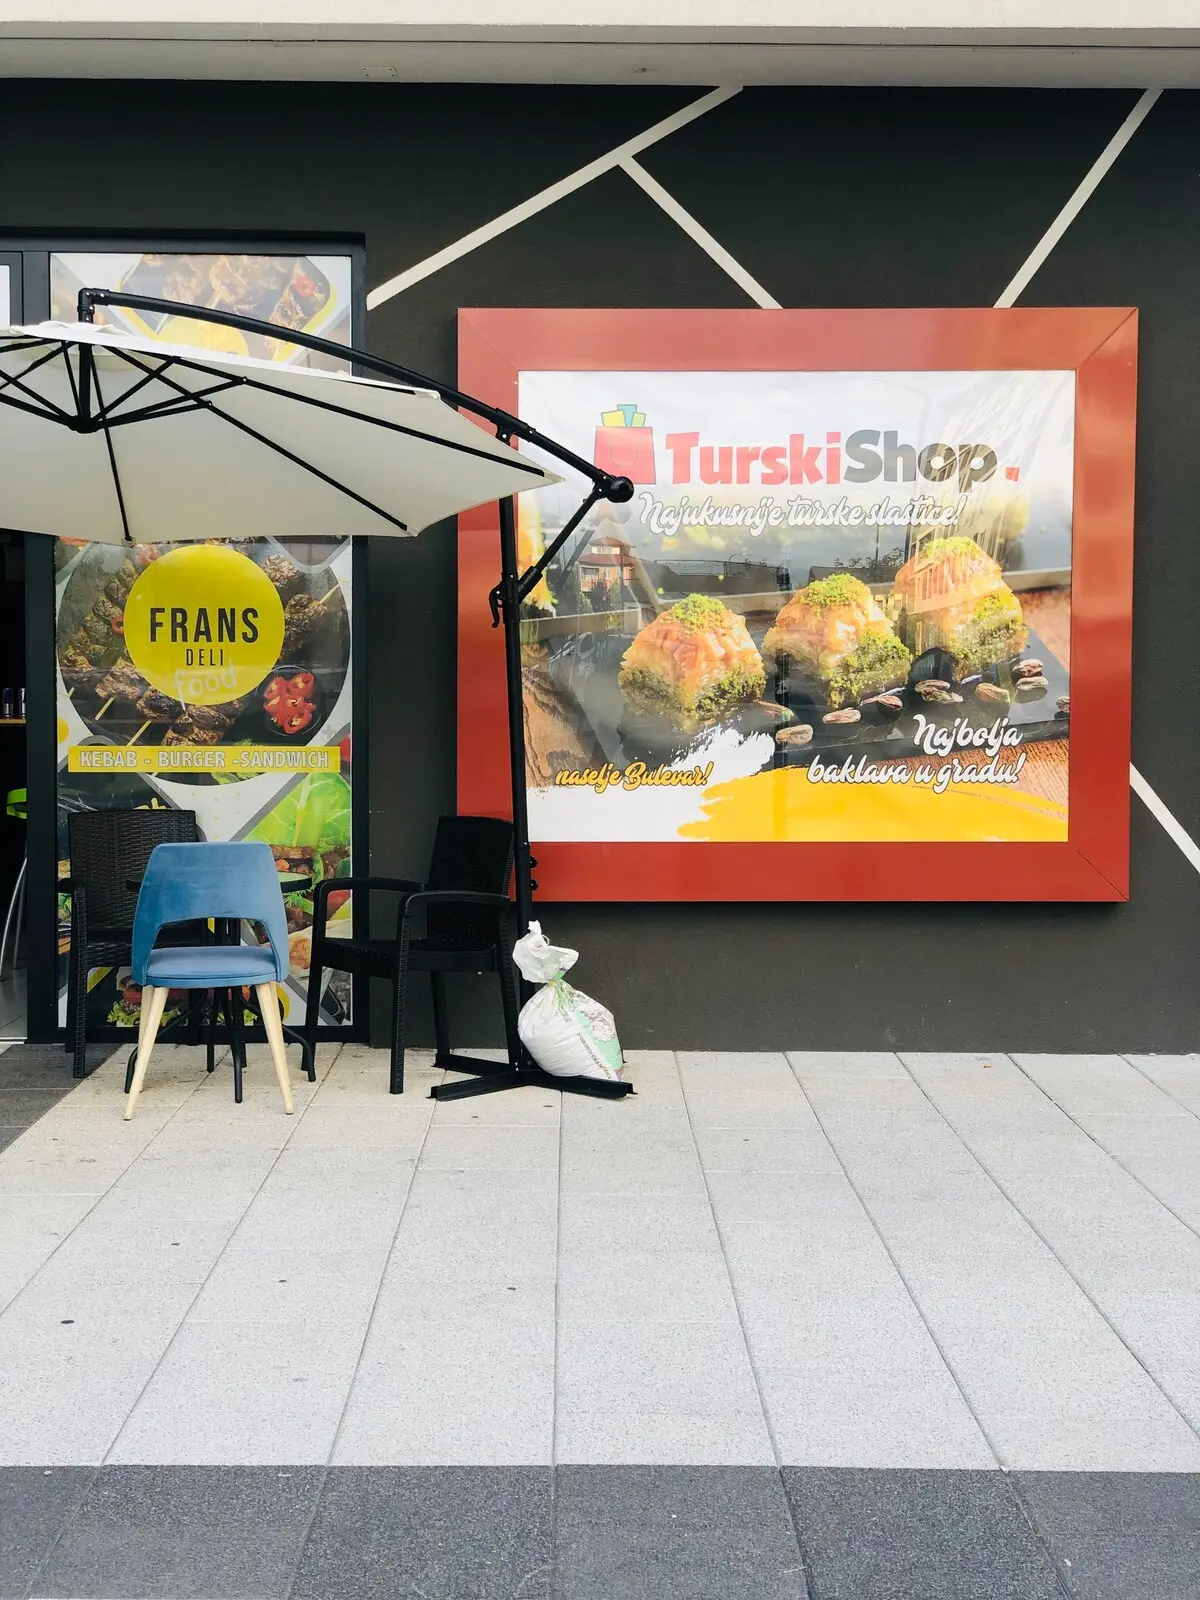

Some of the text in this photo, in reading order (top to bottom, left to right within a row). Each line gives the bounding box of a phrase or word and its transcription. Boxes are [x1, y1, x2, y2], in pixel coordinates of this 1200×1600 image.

[638, 491, 968, 537] Najukusnije turske slastice!
[150, 607, 259, 643] FRANS
[186, 648, 224, 666] DELI
[174, 658, 238, 711] food
[912, 713, 1023, 757] Najbolja
[79, 750, 138, 768] KEBAB
[157, 751, 226, 769] BURGER
[555, 760, 715, 794] naselje Bulevar!
[807, 752, 1028, 795] baklava u gradu!
